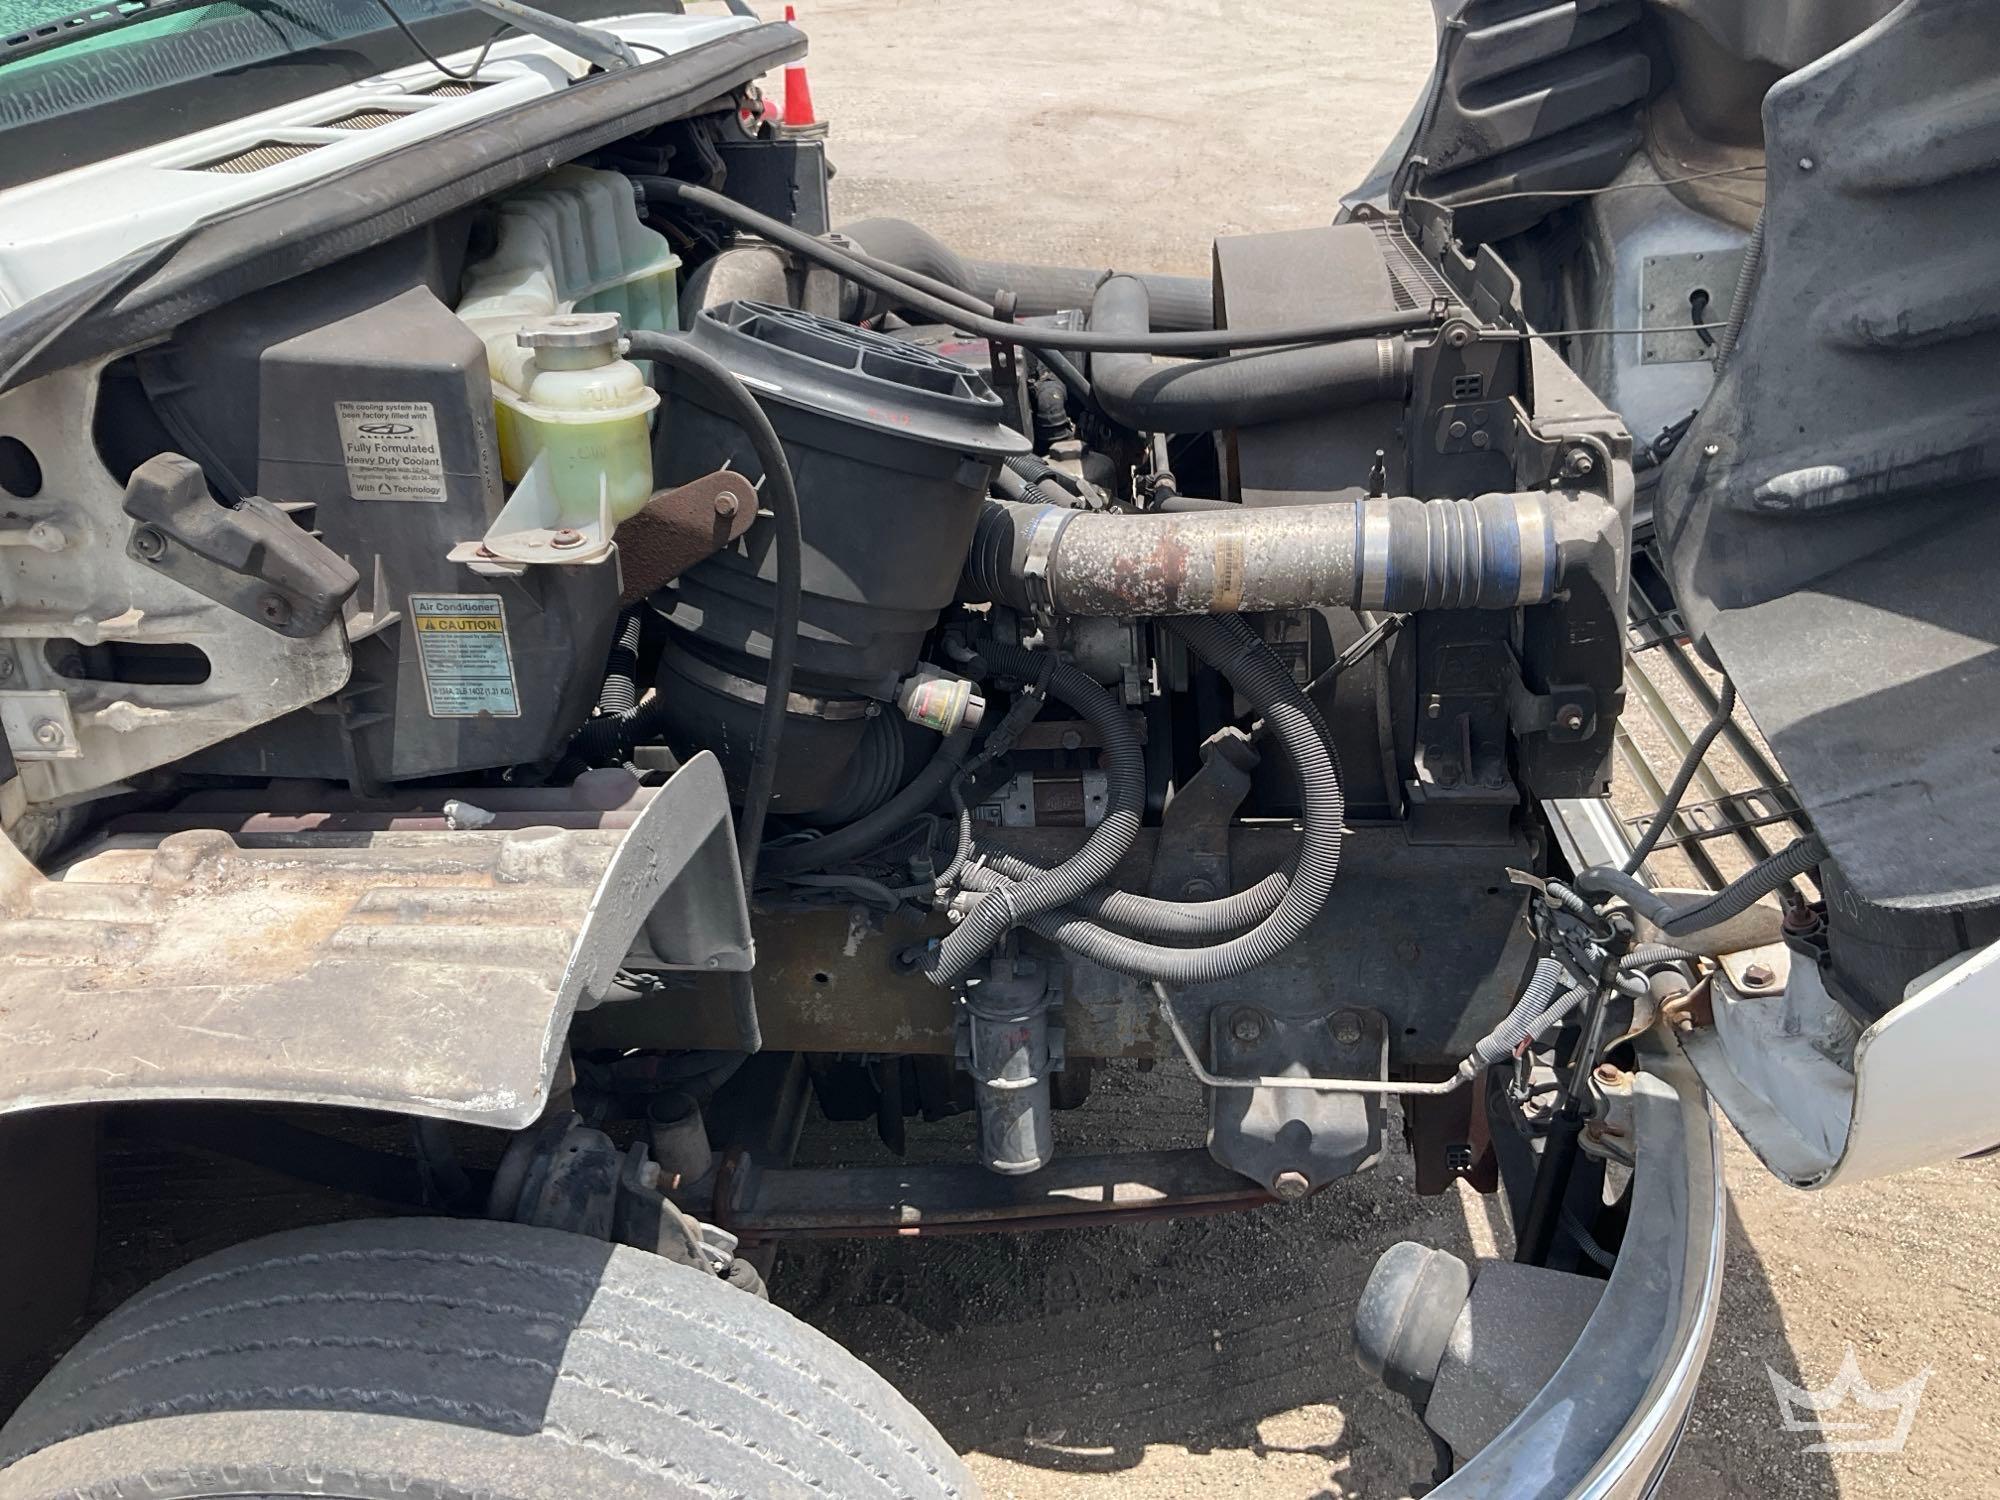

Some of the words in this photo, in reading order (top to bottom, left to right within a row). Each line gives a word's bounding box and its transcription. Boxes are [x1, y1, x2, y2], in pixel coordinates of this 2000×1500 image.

[356, 404, 384, 412] cooling
[362, 412, 389, 420] factory
[347, 443, 371, 454] Fully
[375, 443, 435, 453] Formulated
[346, 456, 375, 465] Heavy
[378, 456, 400, 466] Duty
[402, 457, 440, 466] Coolant
[356, 484, 375, 492] With
[393, 485, 441, 495] Technology
[420, 603, 433, 611] Air
[436, 603, 494, 611] Conditioner
[439, 620, 497, 630] CAUTION
